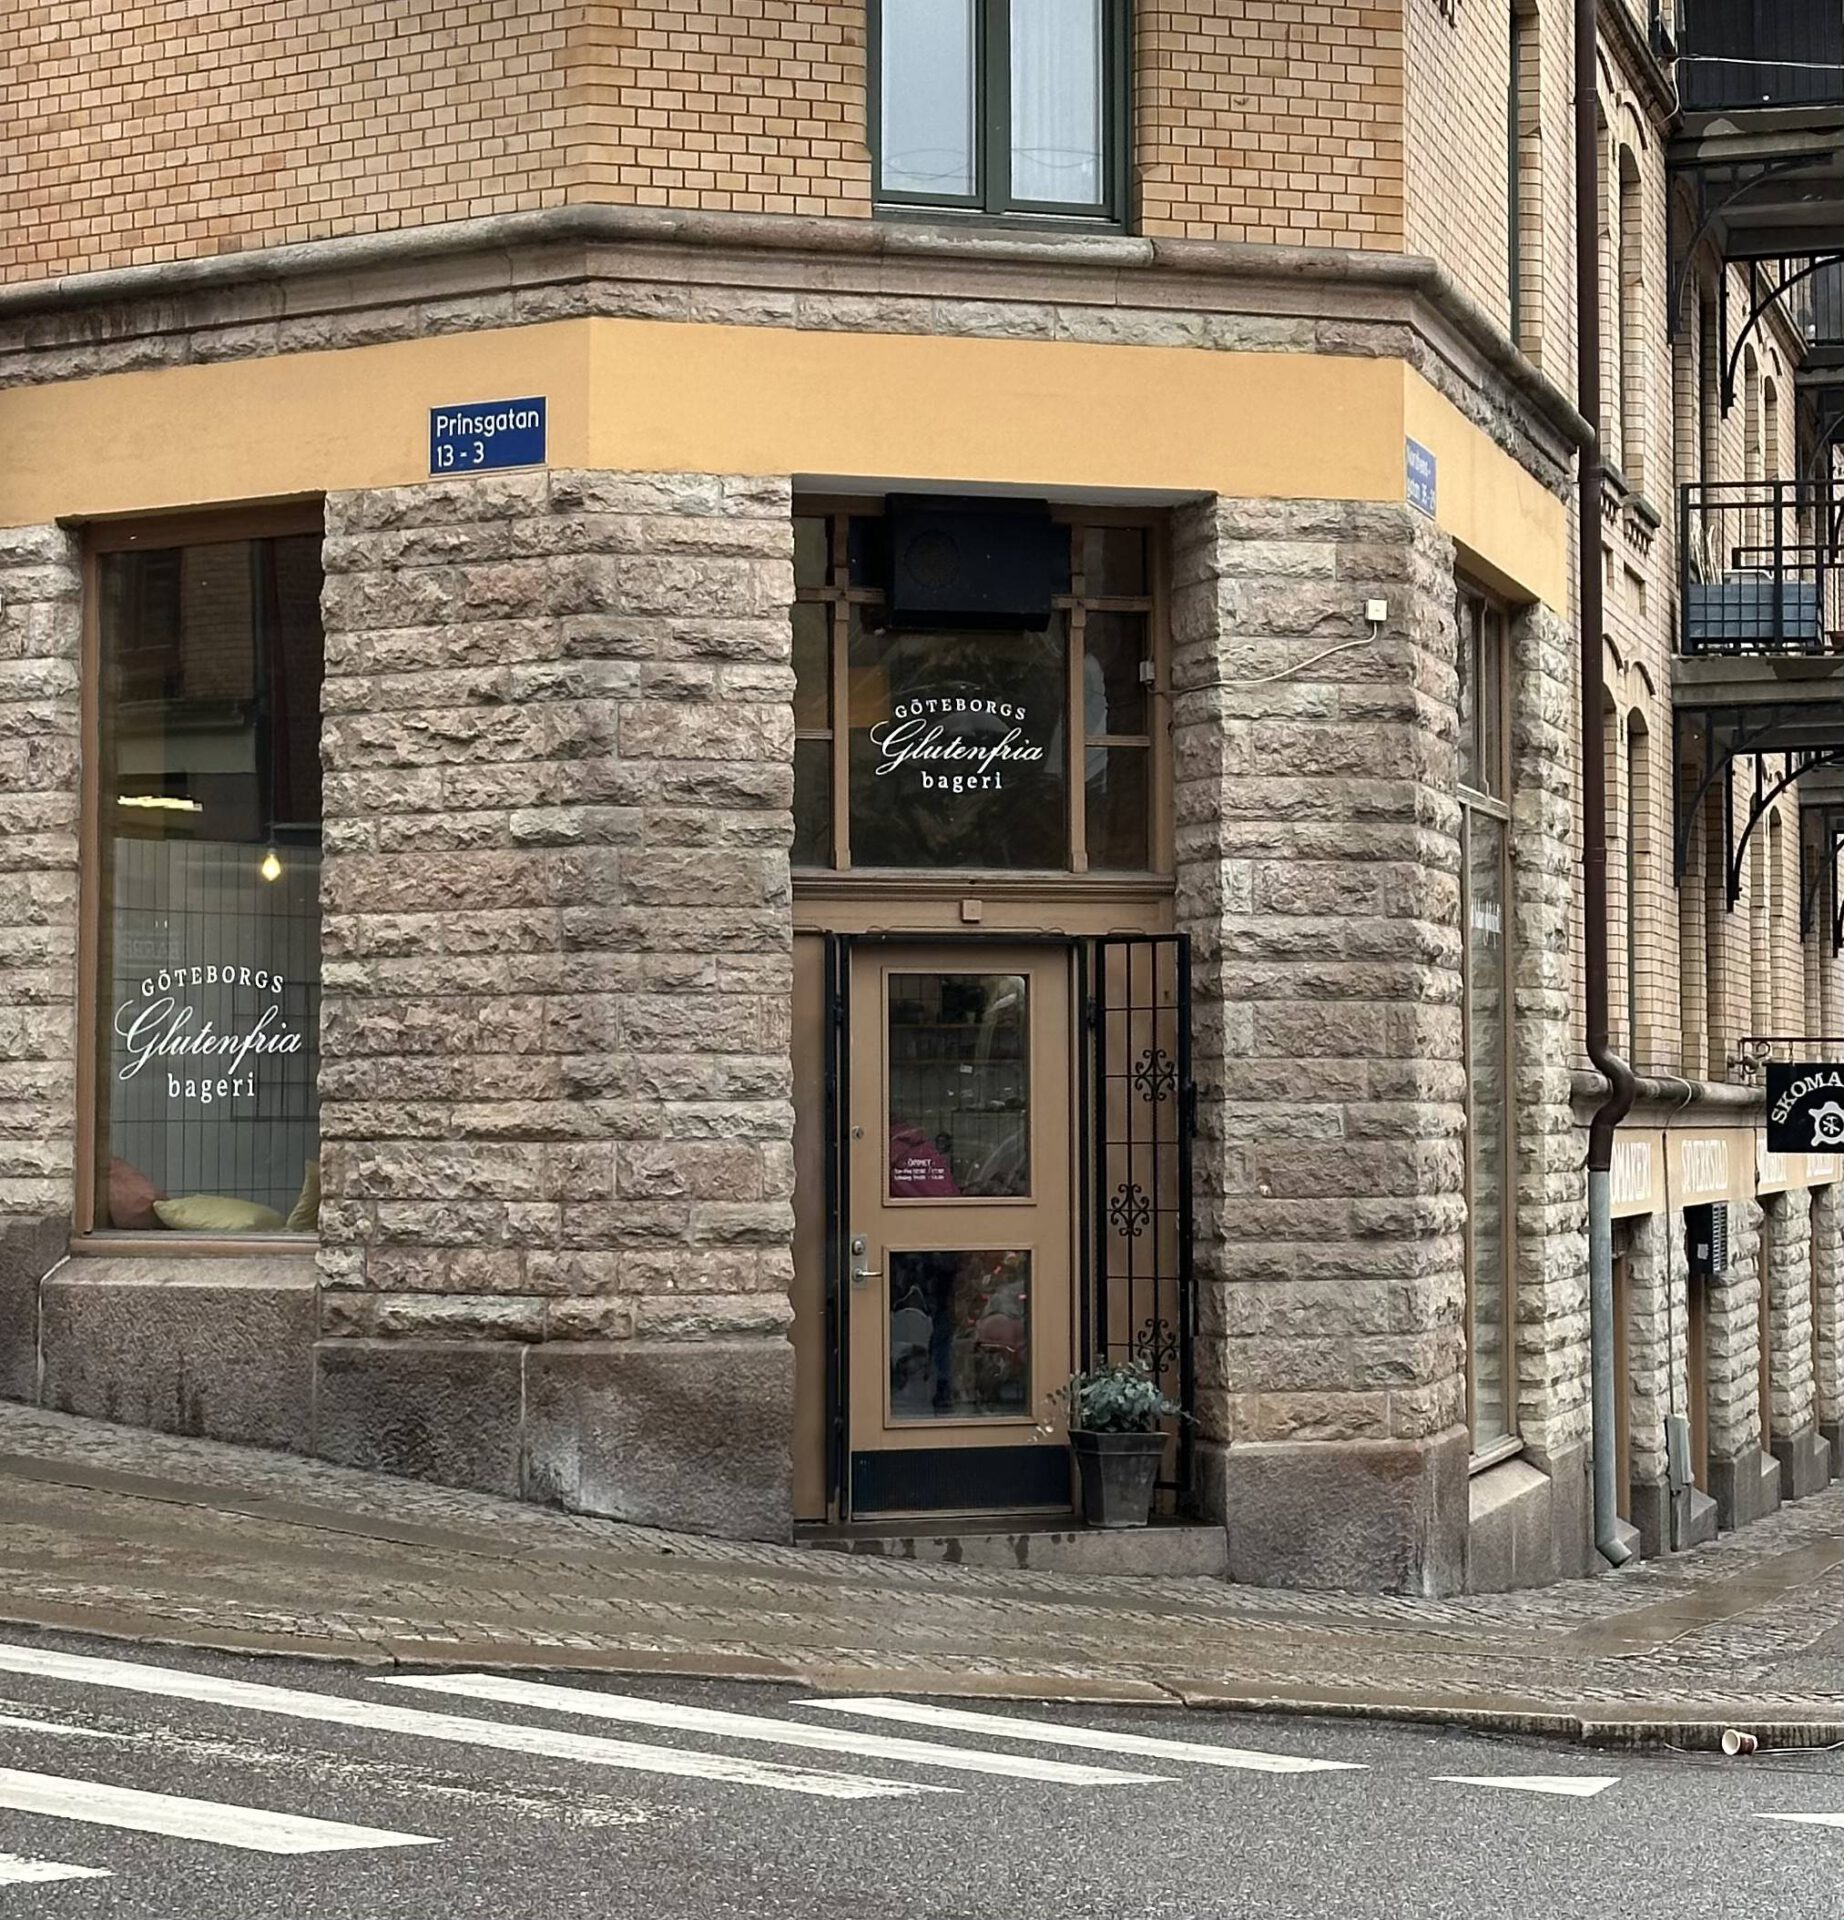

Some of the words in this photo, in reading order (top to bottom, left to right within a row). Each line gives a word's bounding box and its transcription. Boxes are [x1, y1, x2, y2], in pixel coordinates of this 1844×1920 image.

[436, 408, 539, 437] Prinsgatan
[436, 444, 454, 467] 13
[473, 441, 485, 463] 3
[895, 698, 1027, 720] GÖTEBORGS
[869, 718, 1044, 775] Glutenfria
[921, 771, 1002, 793] bageri
[141, 965, 284, 996] GÖTEBORGS
[114, 997, 302, 1080] Glutenfria
[168, 1072, 255, 1103] bageri
[1771, 1071, 1844, 1124] SKOMA
